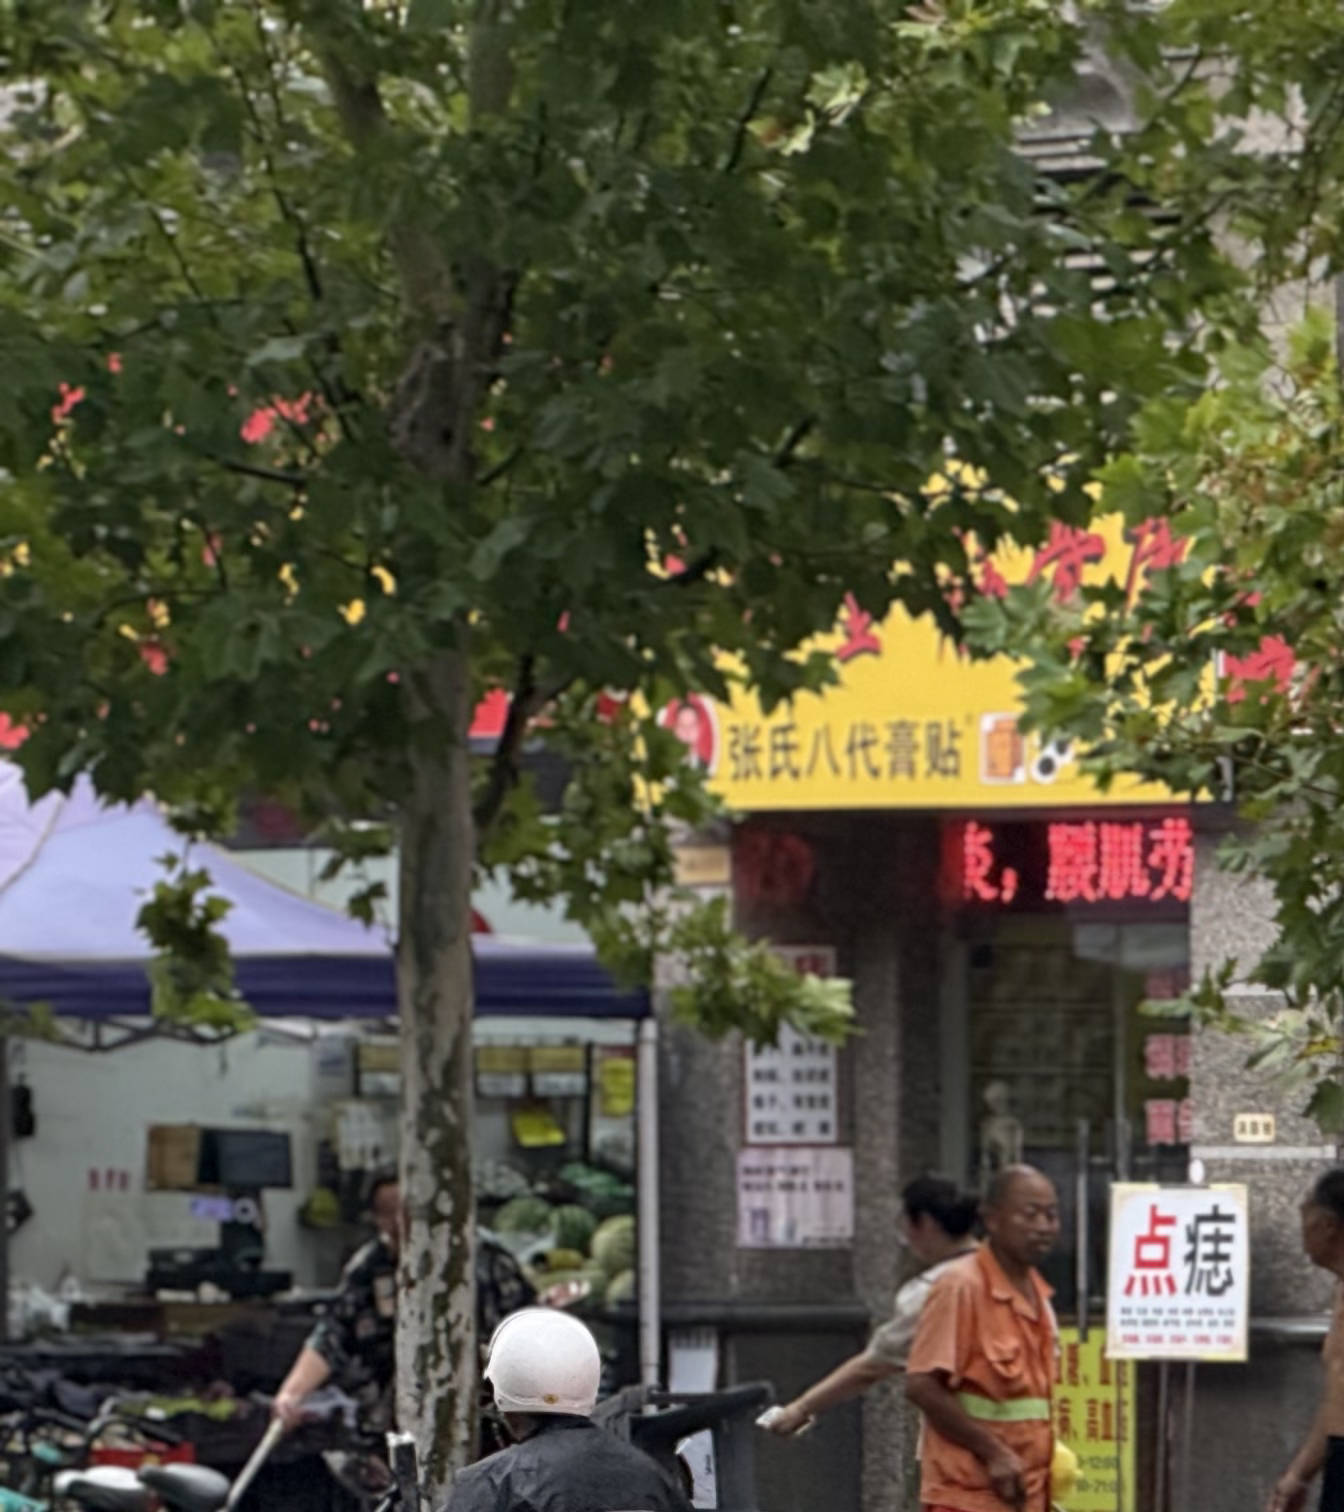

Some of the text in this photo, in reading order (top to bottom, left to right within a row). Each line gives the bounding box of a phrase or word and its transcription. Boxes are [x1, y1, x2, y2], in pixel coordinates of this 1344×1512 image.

[729, 719, 962, 781] 张氏八代膏贴
[1124, 1203, 1236, 1296] 点痣
